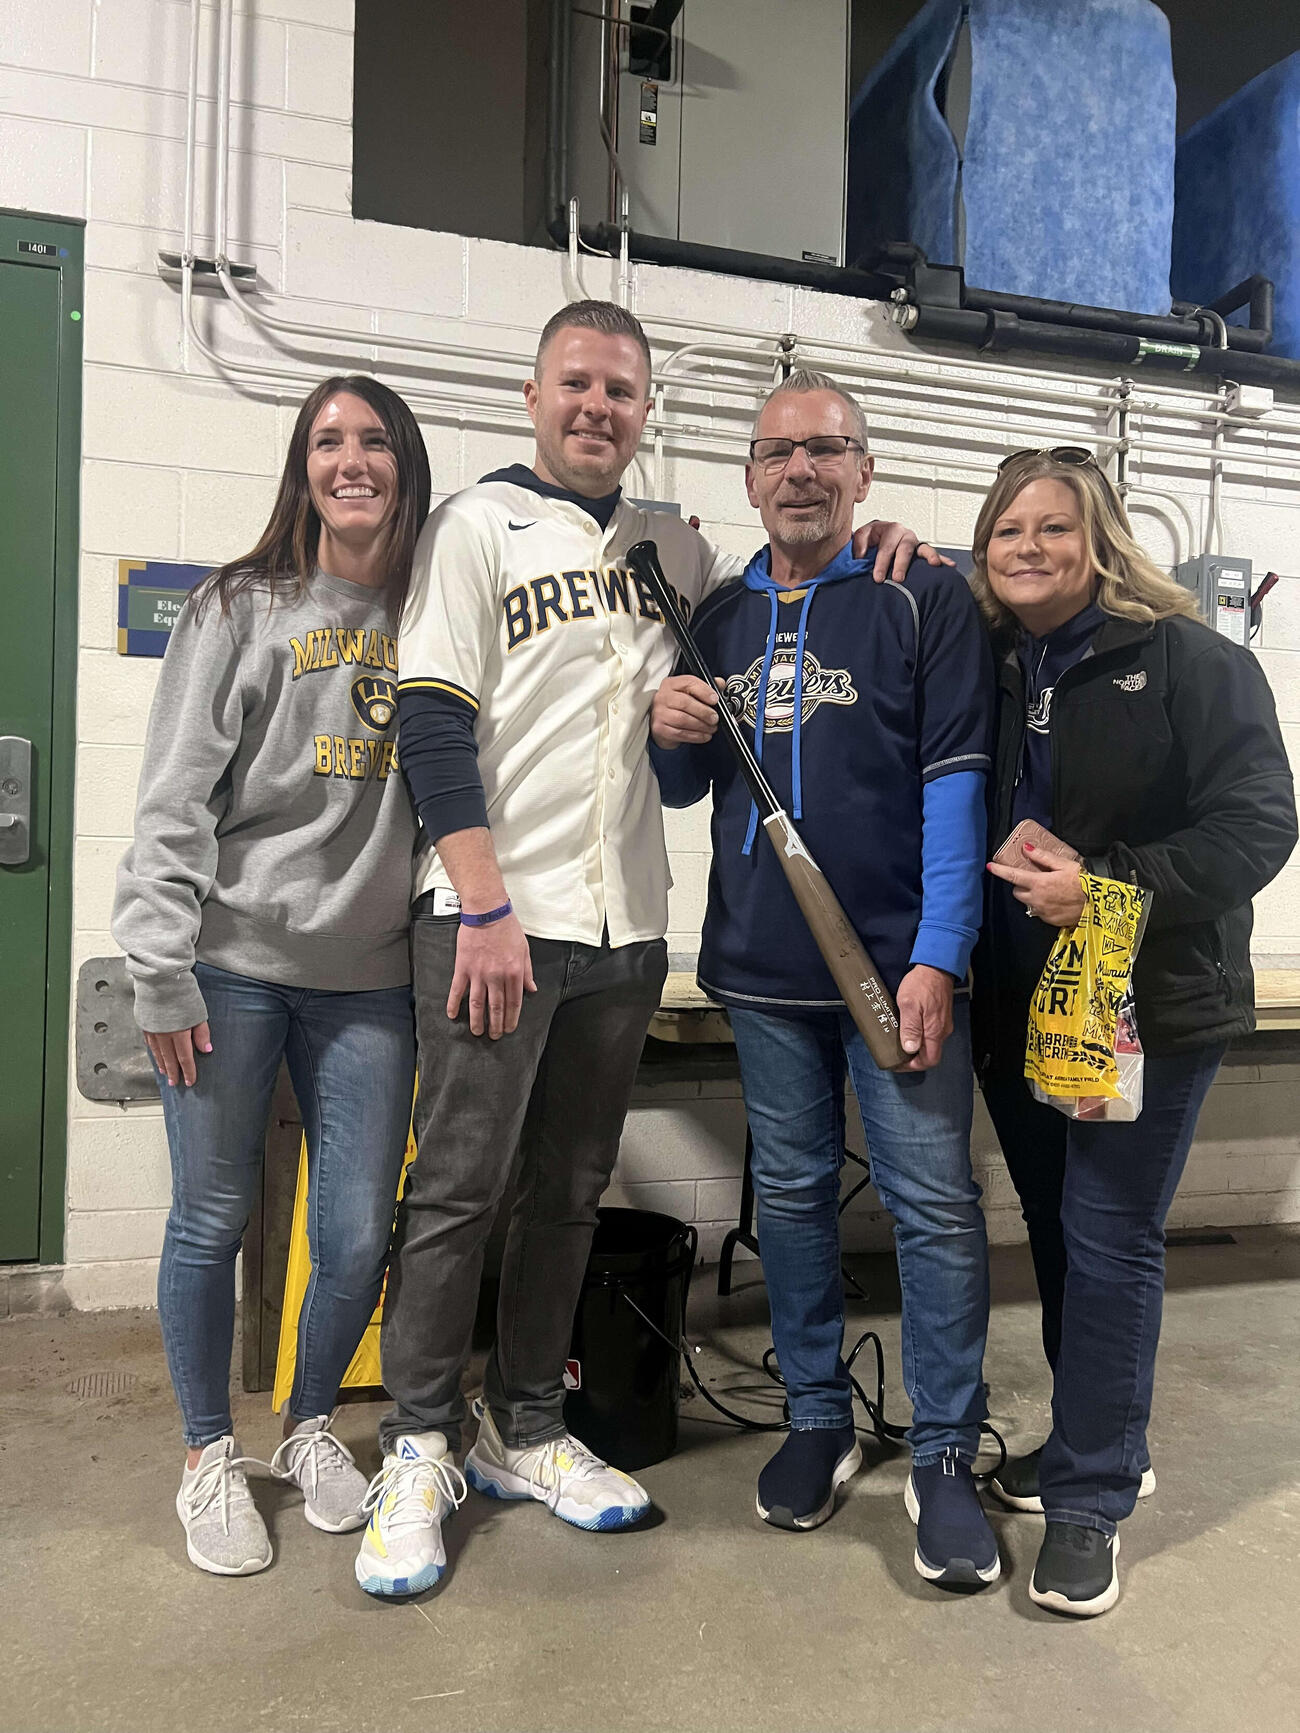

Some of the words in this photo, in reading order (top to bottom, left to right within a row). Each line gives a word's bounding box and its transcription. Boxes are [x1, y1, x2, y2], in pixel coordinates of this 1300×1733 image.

[28, 243, 47, 254] 1401
[1154, 344, 1183, 355] DRAIN
[503, 568, 691, 654] BREWE
[750, 654, 816, 680] MIWAUEE
[869, 976, 882, 994] PRO
[879, 995, 898, 1028] LIMITED
